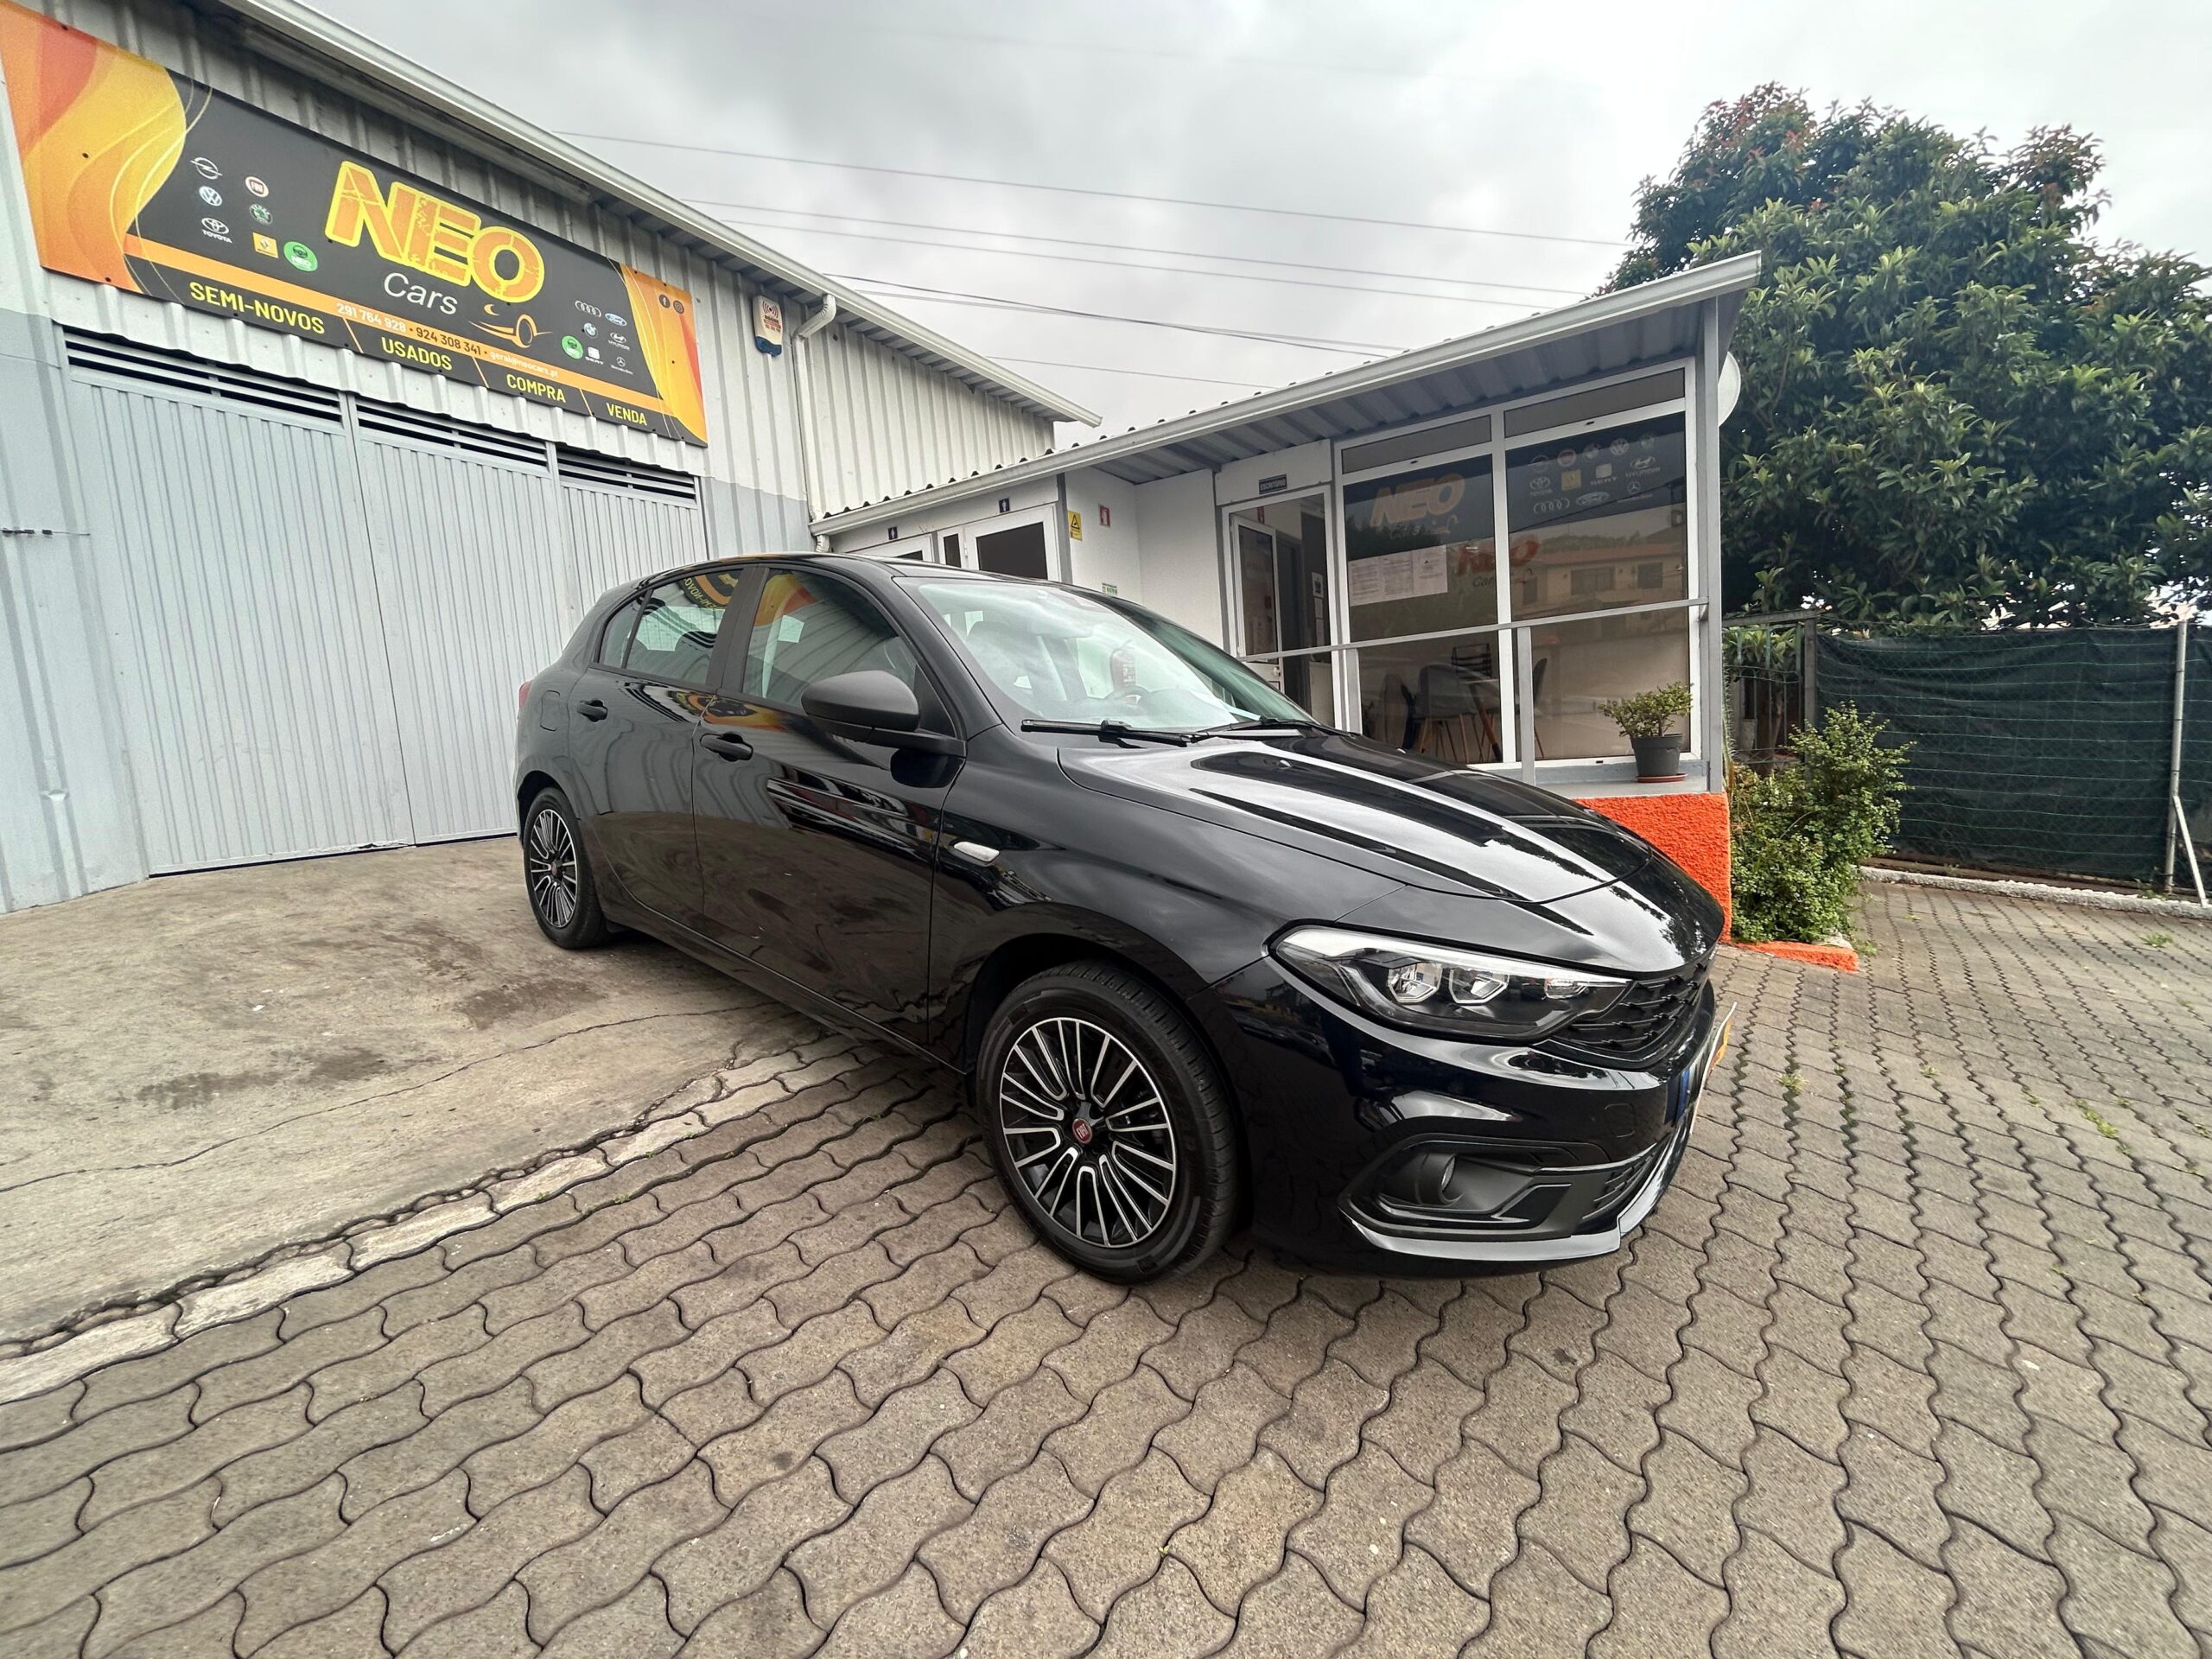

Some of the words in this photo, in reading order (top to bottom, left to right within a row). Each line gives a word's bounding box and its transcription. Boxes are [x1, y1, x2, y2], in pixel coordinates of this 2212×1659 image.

[201, 229, 233, 244] TOYOTA
[325, 161, 545, 303] NEO
[189, 282, 326, 334] SEMI-NOVOS
[384, 272, 458, 315] Cars
[337, 302, 358, 319] 291
[359, 309, 382, 326] 764
[384, 317, 407, 333] 928
[416, 327, 438, 343] 924
[440, 334, 461, 349] 308
[464, 341, 481, 356] 341
[381, 336, 453, 371] USADOS
[505, 373, 567, 404] COMPRA
[606, 402, 648, 426] VENDA
[1370, 474, 1465, 528] NEO
[1472, 573, 1497, 588] Car
